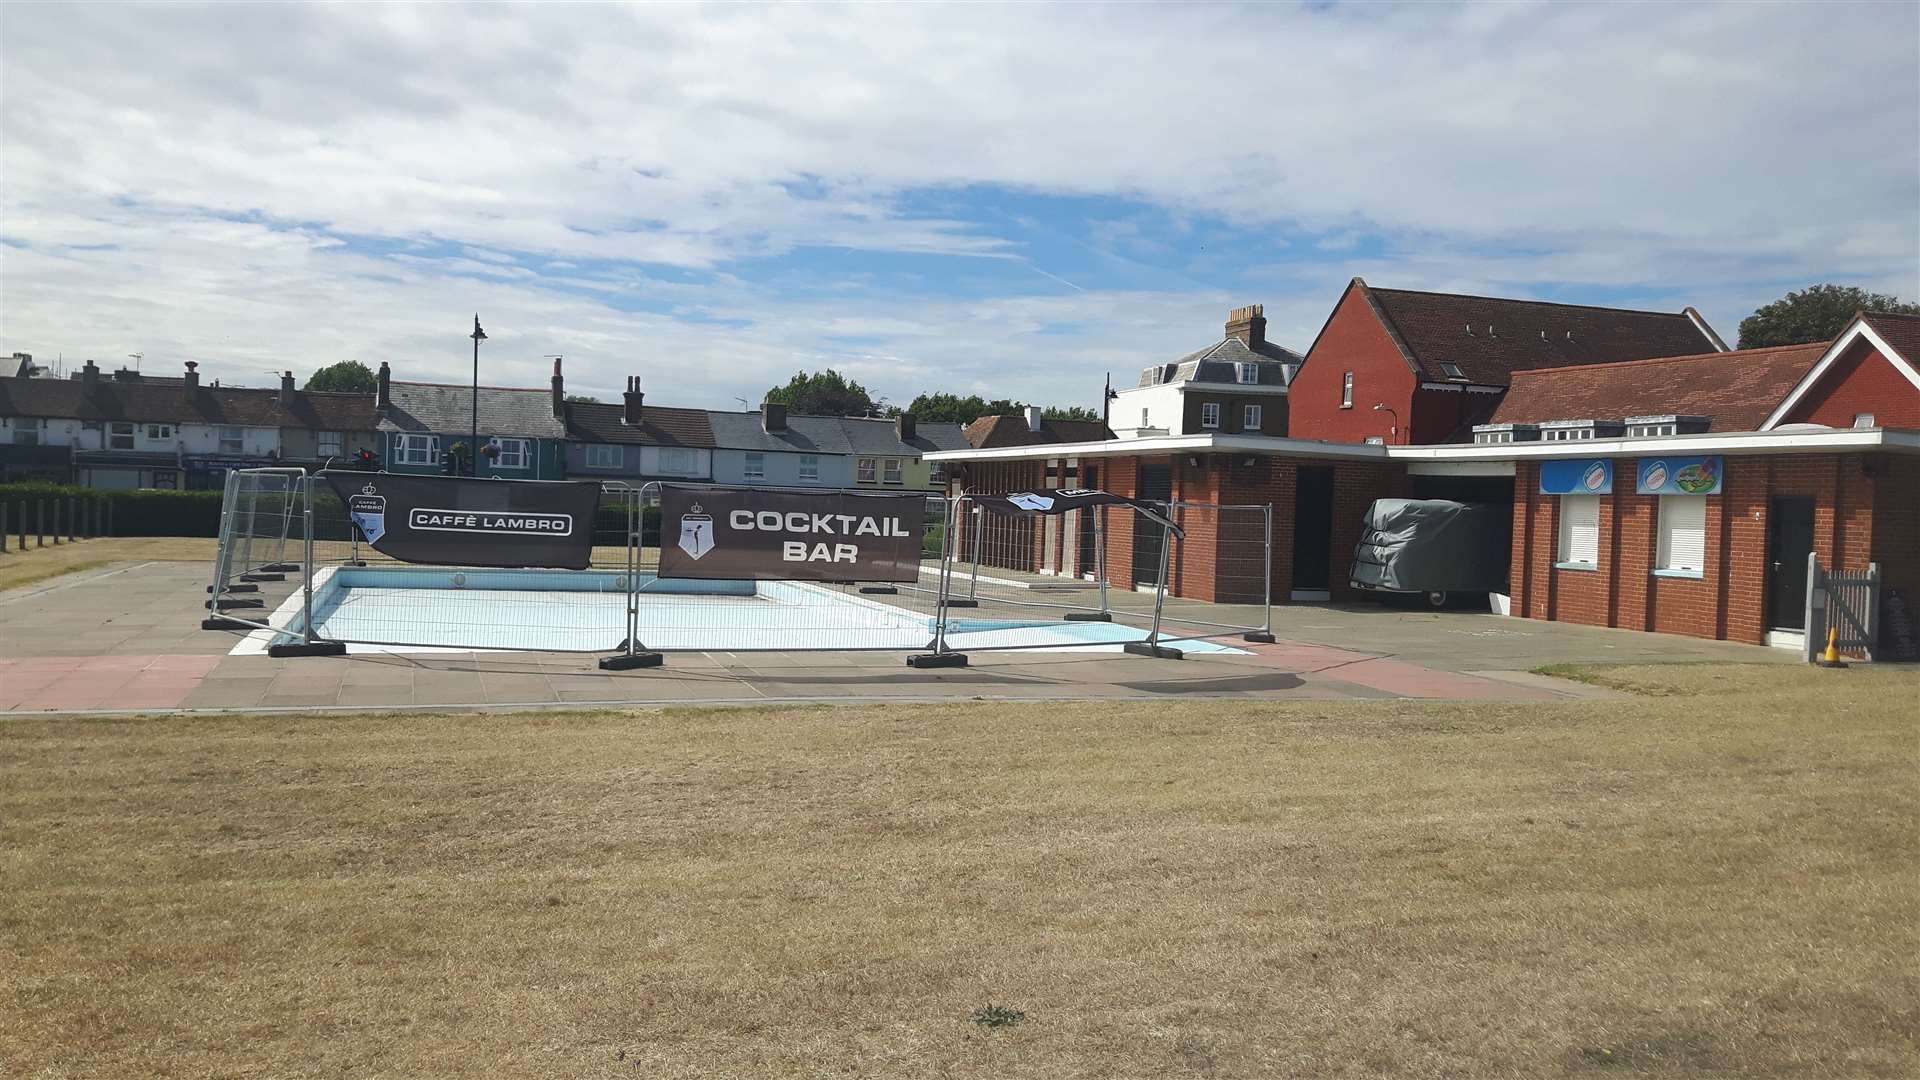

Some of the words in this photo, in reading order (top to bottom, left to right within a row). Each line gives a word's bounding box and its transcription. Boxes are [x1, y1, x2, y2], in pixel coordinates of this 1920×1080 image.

[416, 514, 476, 527] CAFFÈ
[483, 518, 565, 530] LAMBRO
[729, 510, 910, 537] COCKTAIL
[783, 541, 858, 564] BAR
